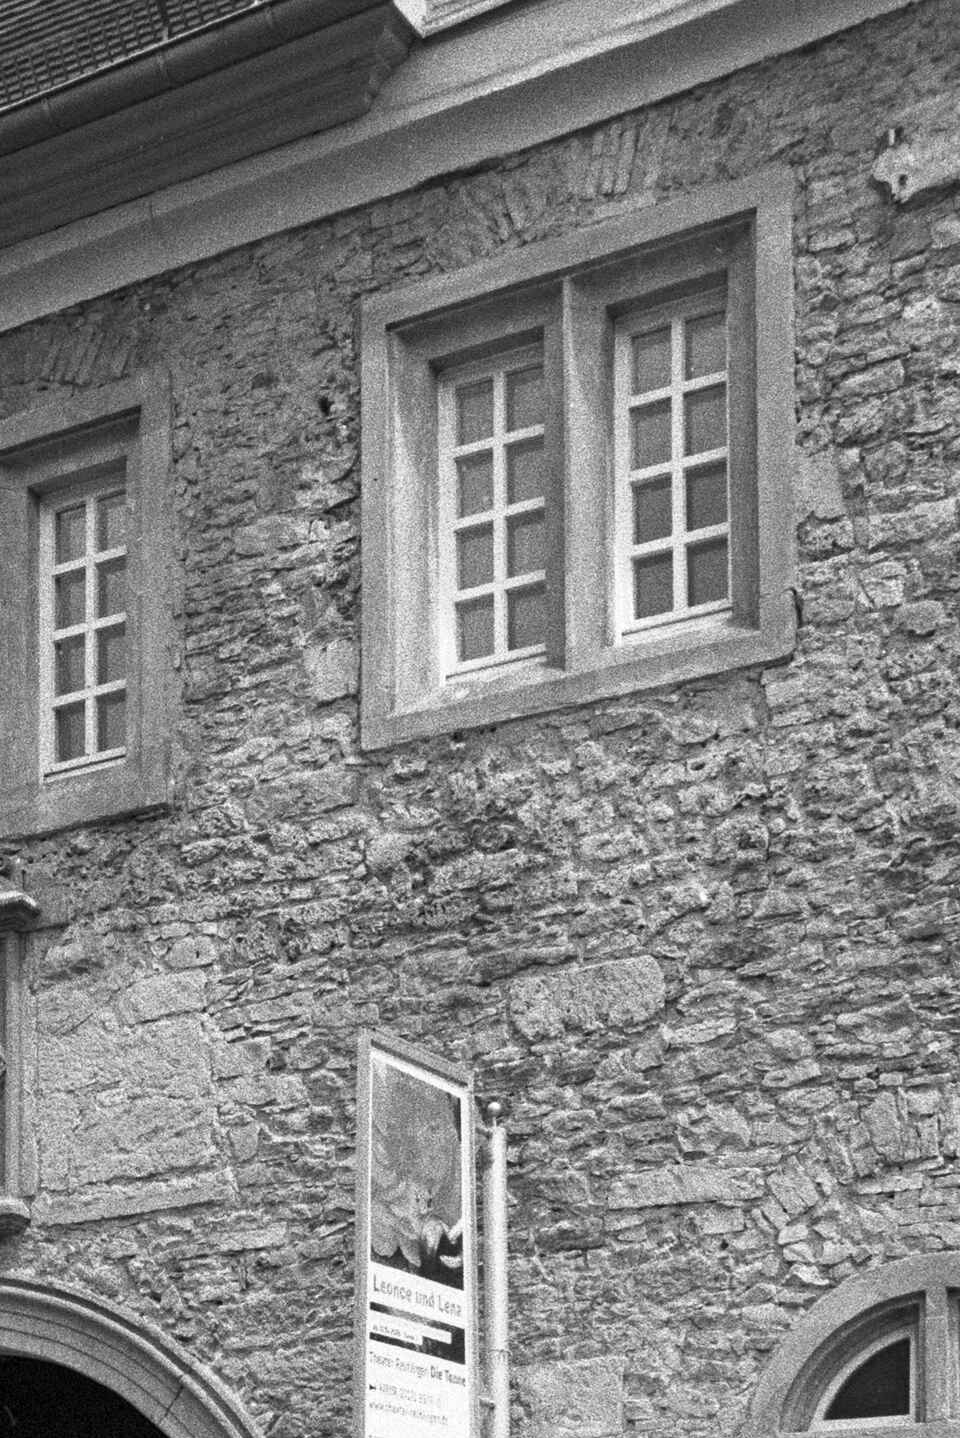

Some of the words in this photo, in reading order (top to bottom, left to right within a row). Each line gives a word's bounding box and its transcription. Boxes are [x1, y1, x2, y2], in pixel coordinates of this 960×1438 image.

[373, 1274, 412, 1302] Leonce
[415, 1291, 435, 1308] und
[438, 1294, 462, 1316] Lenz
